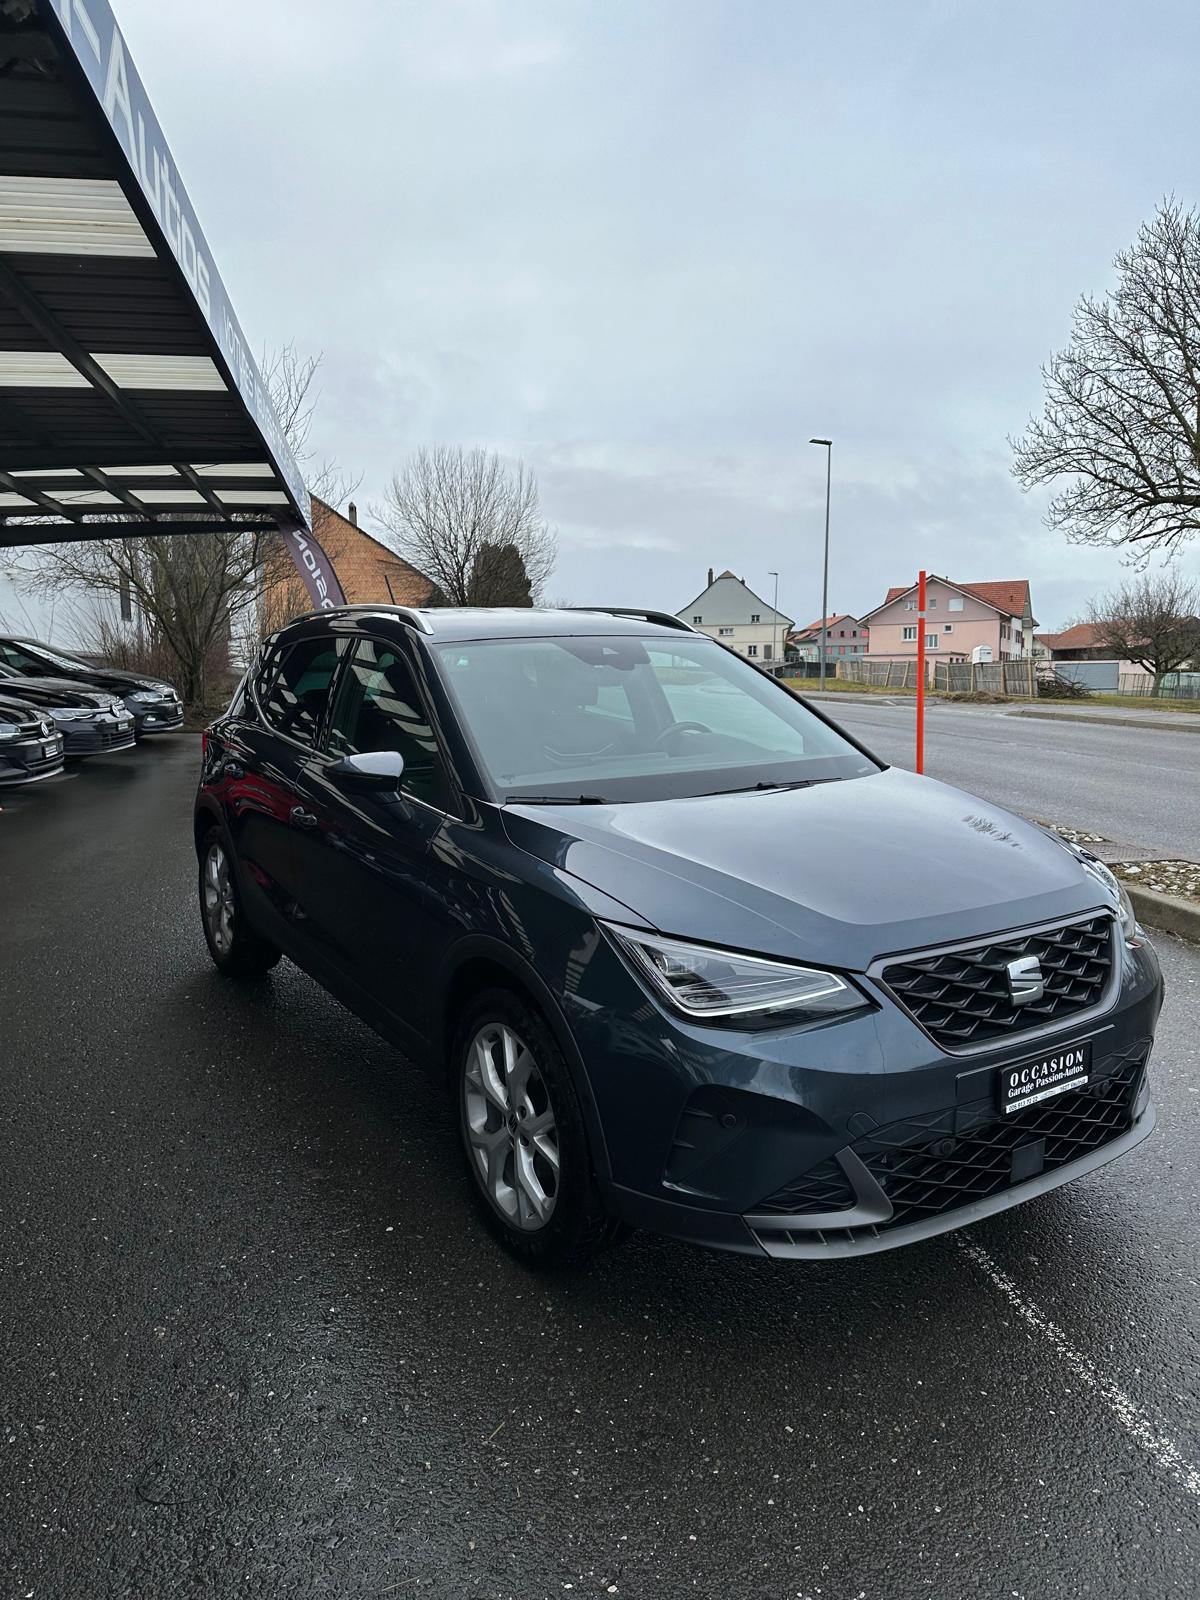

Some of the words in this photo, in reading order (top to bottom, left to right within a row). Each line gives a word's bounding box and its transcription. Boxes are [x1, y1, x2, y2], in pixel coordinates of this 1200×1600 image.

[1008, 1082, 1035, 1098] Garage
[1036, 1064, 1084, 1088] Passion-Autos
[1010, 1049, 1084, 1087] OCCASION
